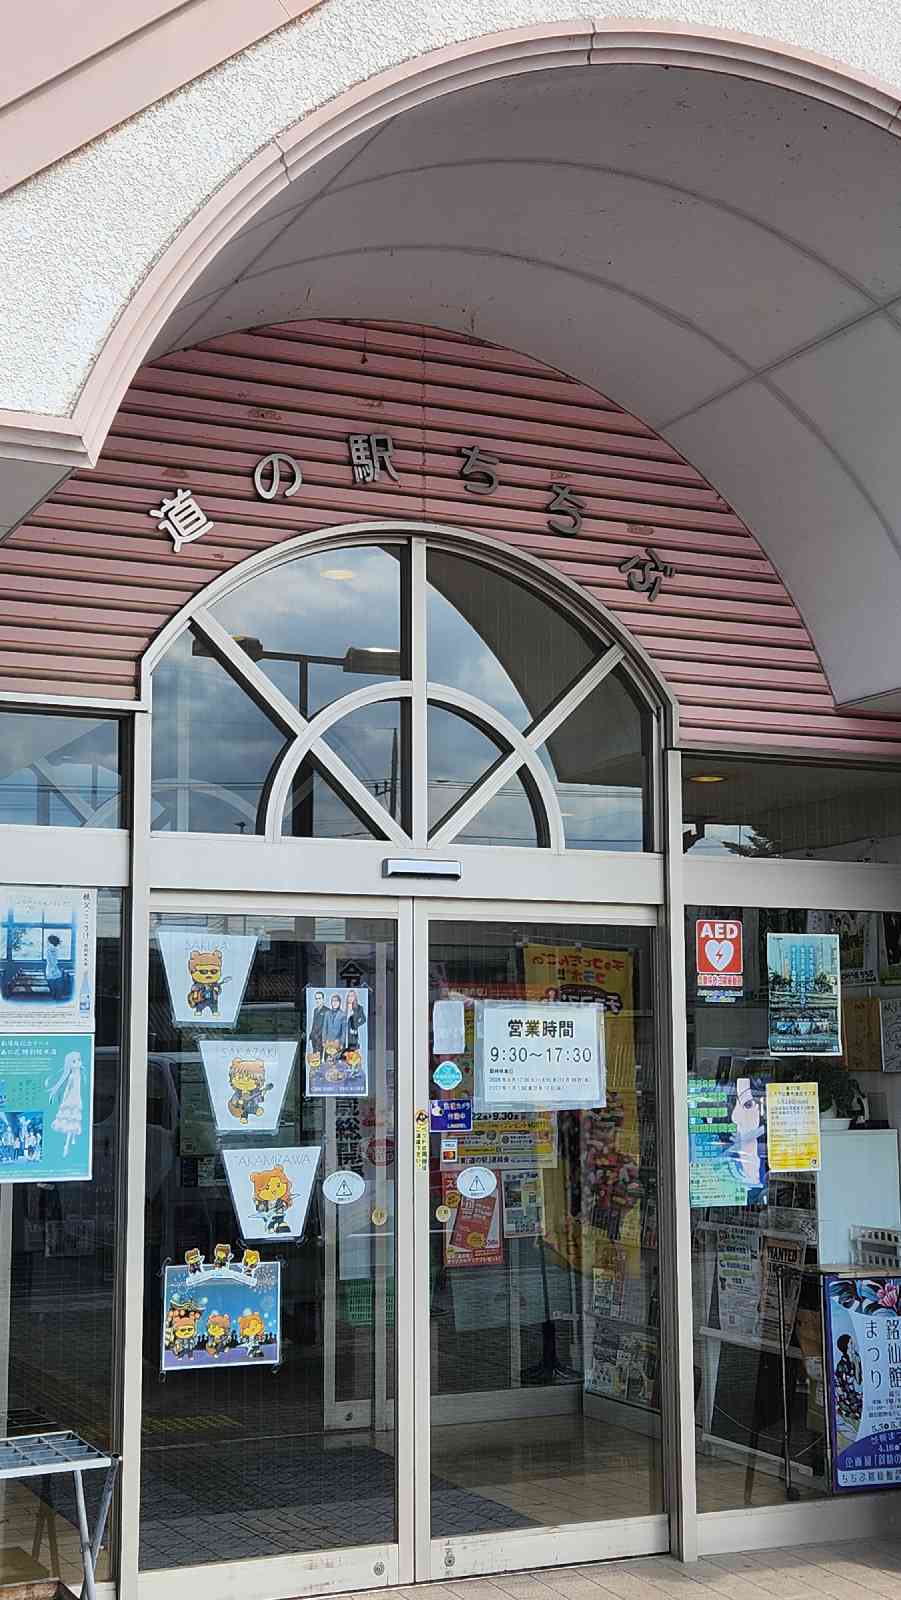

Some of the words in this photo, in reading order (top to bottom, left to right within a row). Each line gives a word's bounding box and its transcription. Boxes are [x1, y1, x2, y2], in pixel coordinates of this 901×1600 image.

[149, 432, 676, 602] 道の駅ちちぶ
[700, 923, 738, 940] AED
[507, 1018, 575, 1039] 営業時間
[767, 1247, 800, 1265] WANTED
[864, 1319, 882, 1390] まつり
